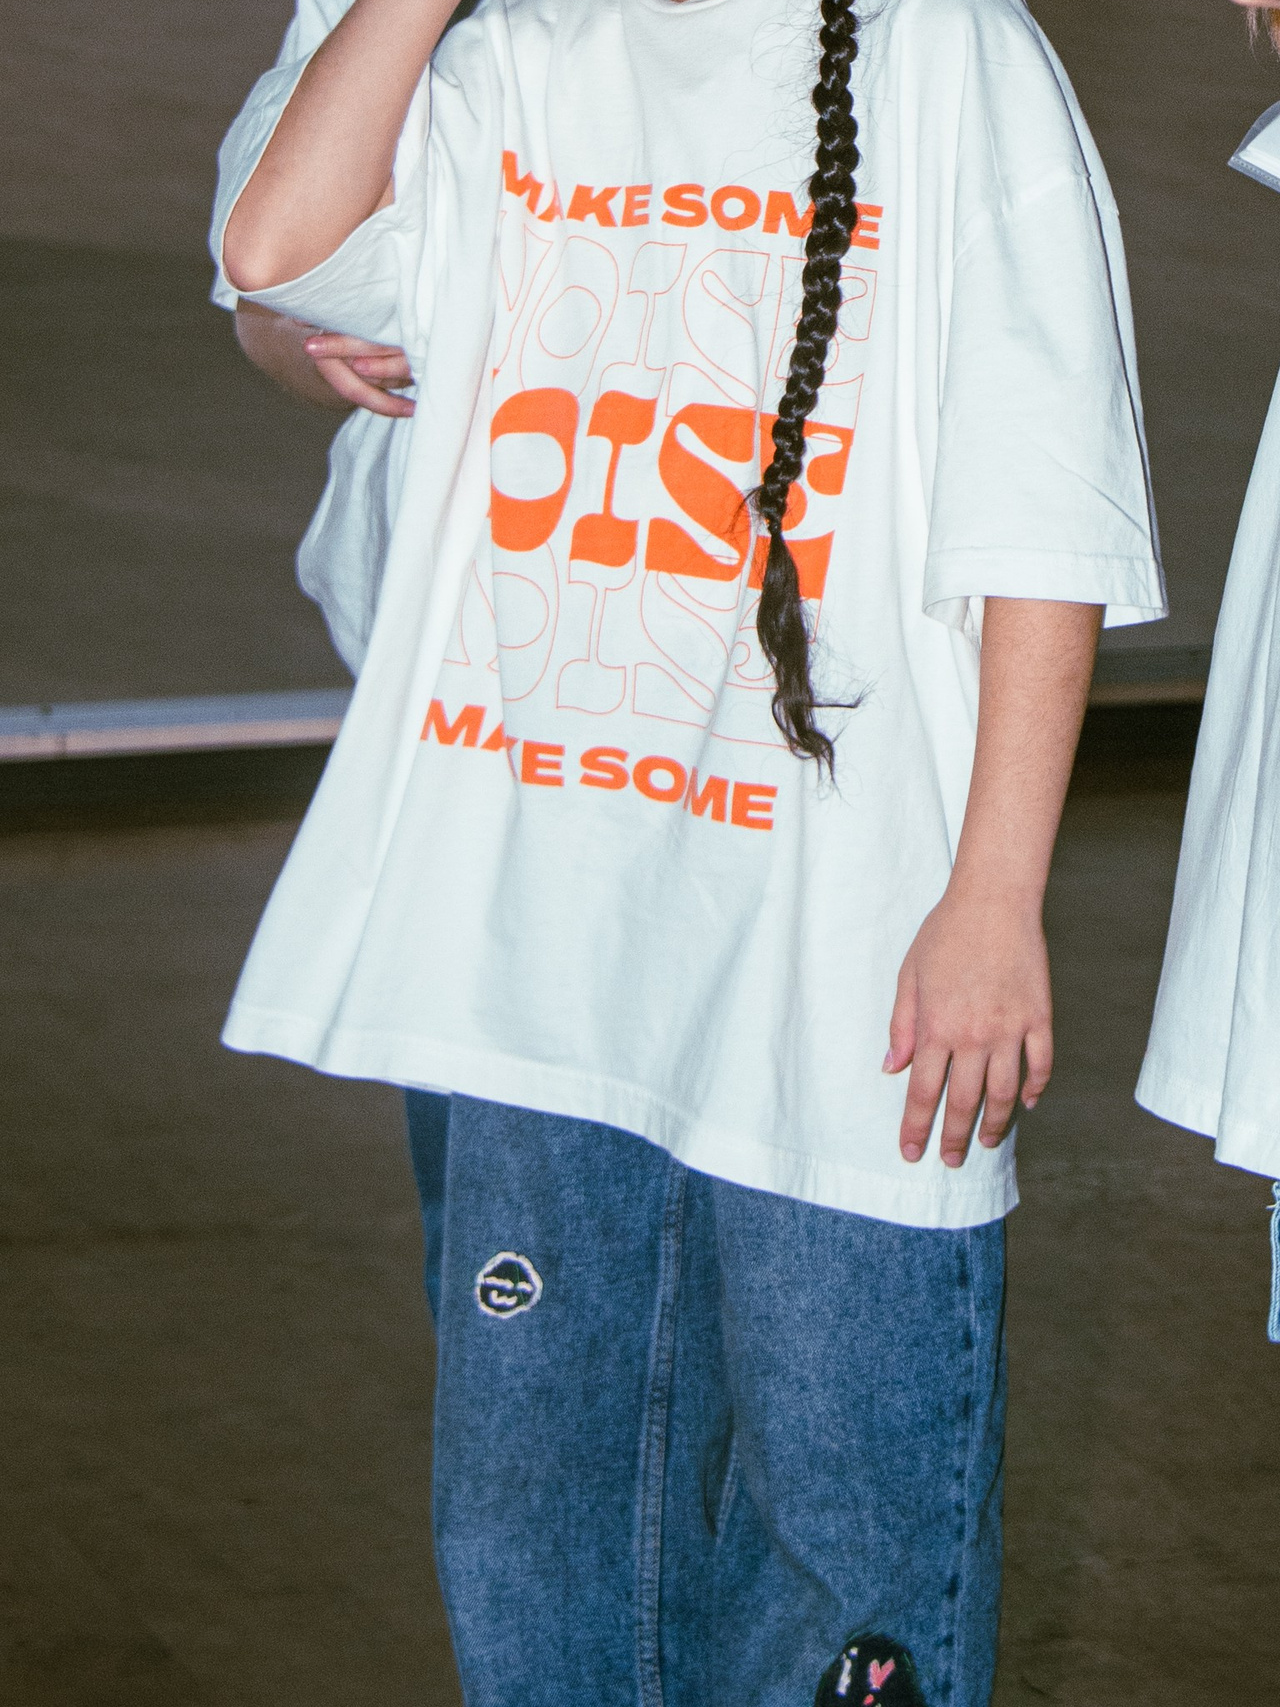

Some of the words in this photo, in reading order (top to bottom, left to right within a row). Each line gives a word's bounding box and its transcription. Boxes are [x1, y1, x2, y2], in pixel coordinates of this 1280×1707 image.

[661, 183, 884, 250] SOME
[488, 387, 856, 600] OISE
[579, 746, 778, 831] SOME
